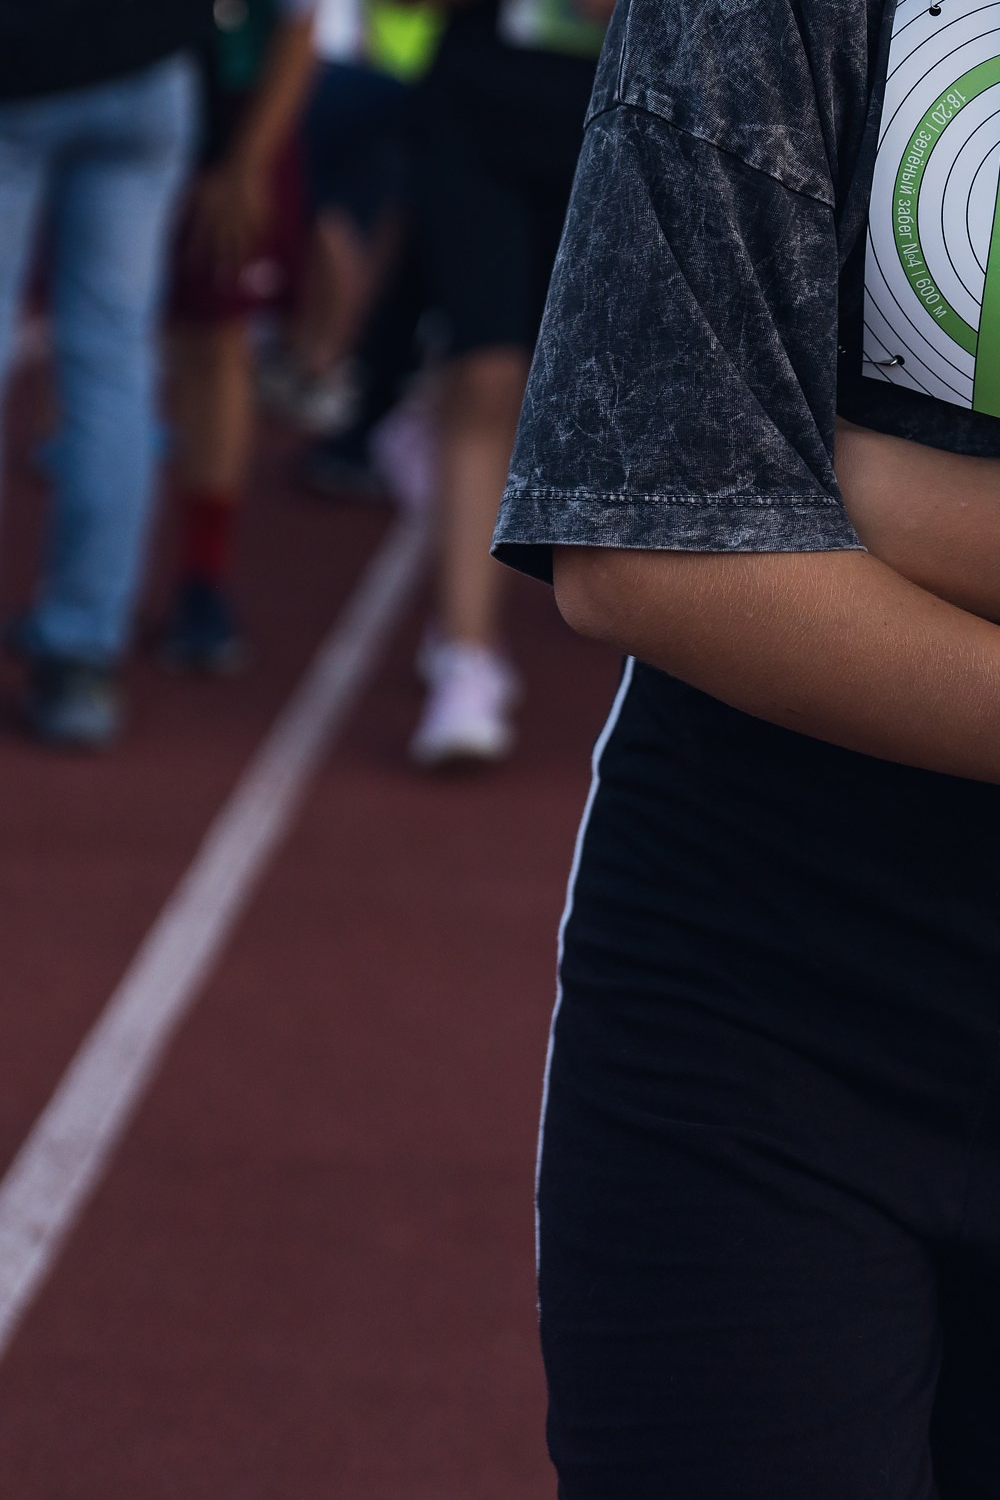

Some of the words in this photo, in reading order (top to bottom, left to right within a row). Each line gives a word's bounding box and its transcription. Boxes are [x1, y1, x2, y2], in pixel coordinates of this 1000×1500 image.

[931, 88, 967, 125] 18:20
[900, 130, 932, 195] зелёный
[898, 199, 914, 238] забег
[902, 243, 923, 268] №4
[916, 278, 940, 304] 600
[933, 306, 947, 318] м
